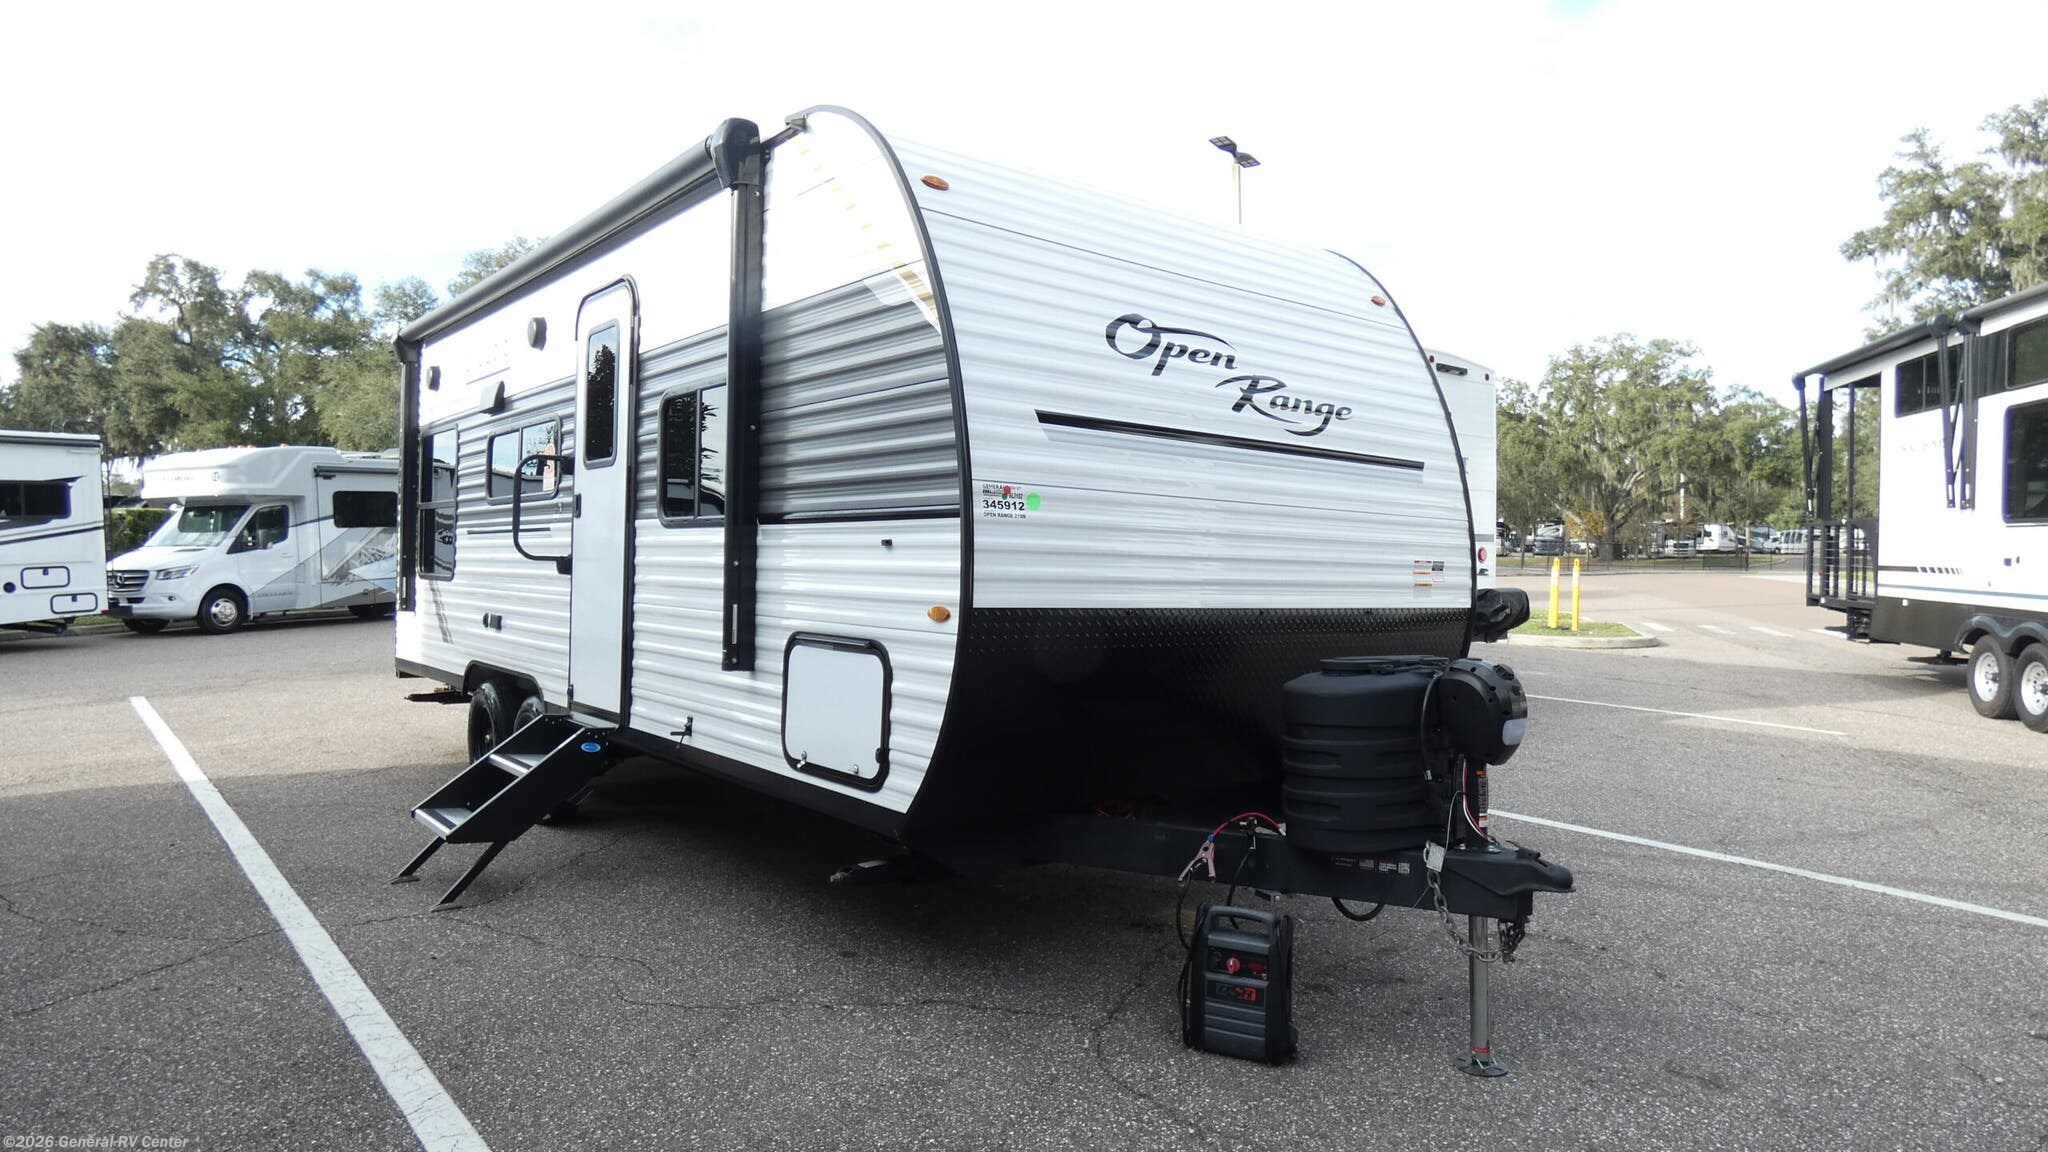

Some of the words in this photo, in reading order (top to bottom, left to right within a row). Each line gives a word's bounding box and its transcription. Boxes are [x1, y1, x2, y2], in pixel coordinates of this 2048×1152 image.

[1105, 313, 1237, 376] Open
[1215, 375, 1352, 436] Range
[982, 499, 1025, 511] 345912
